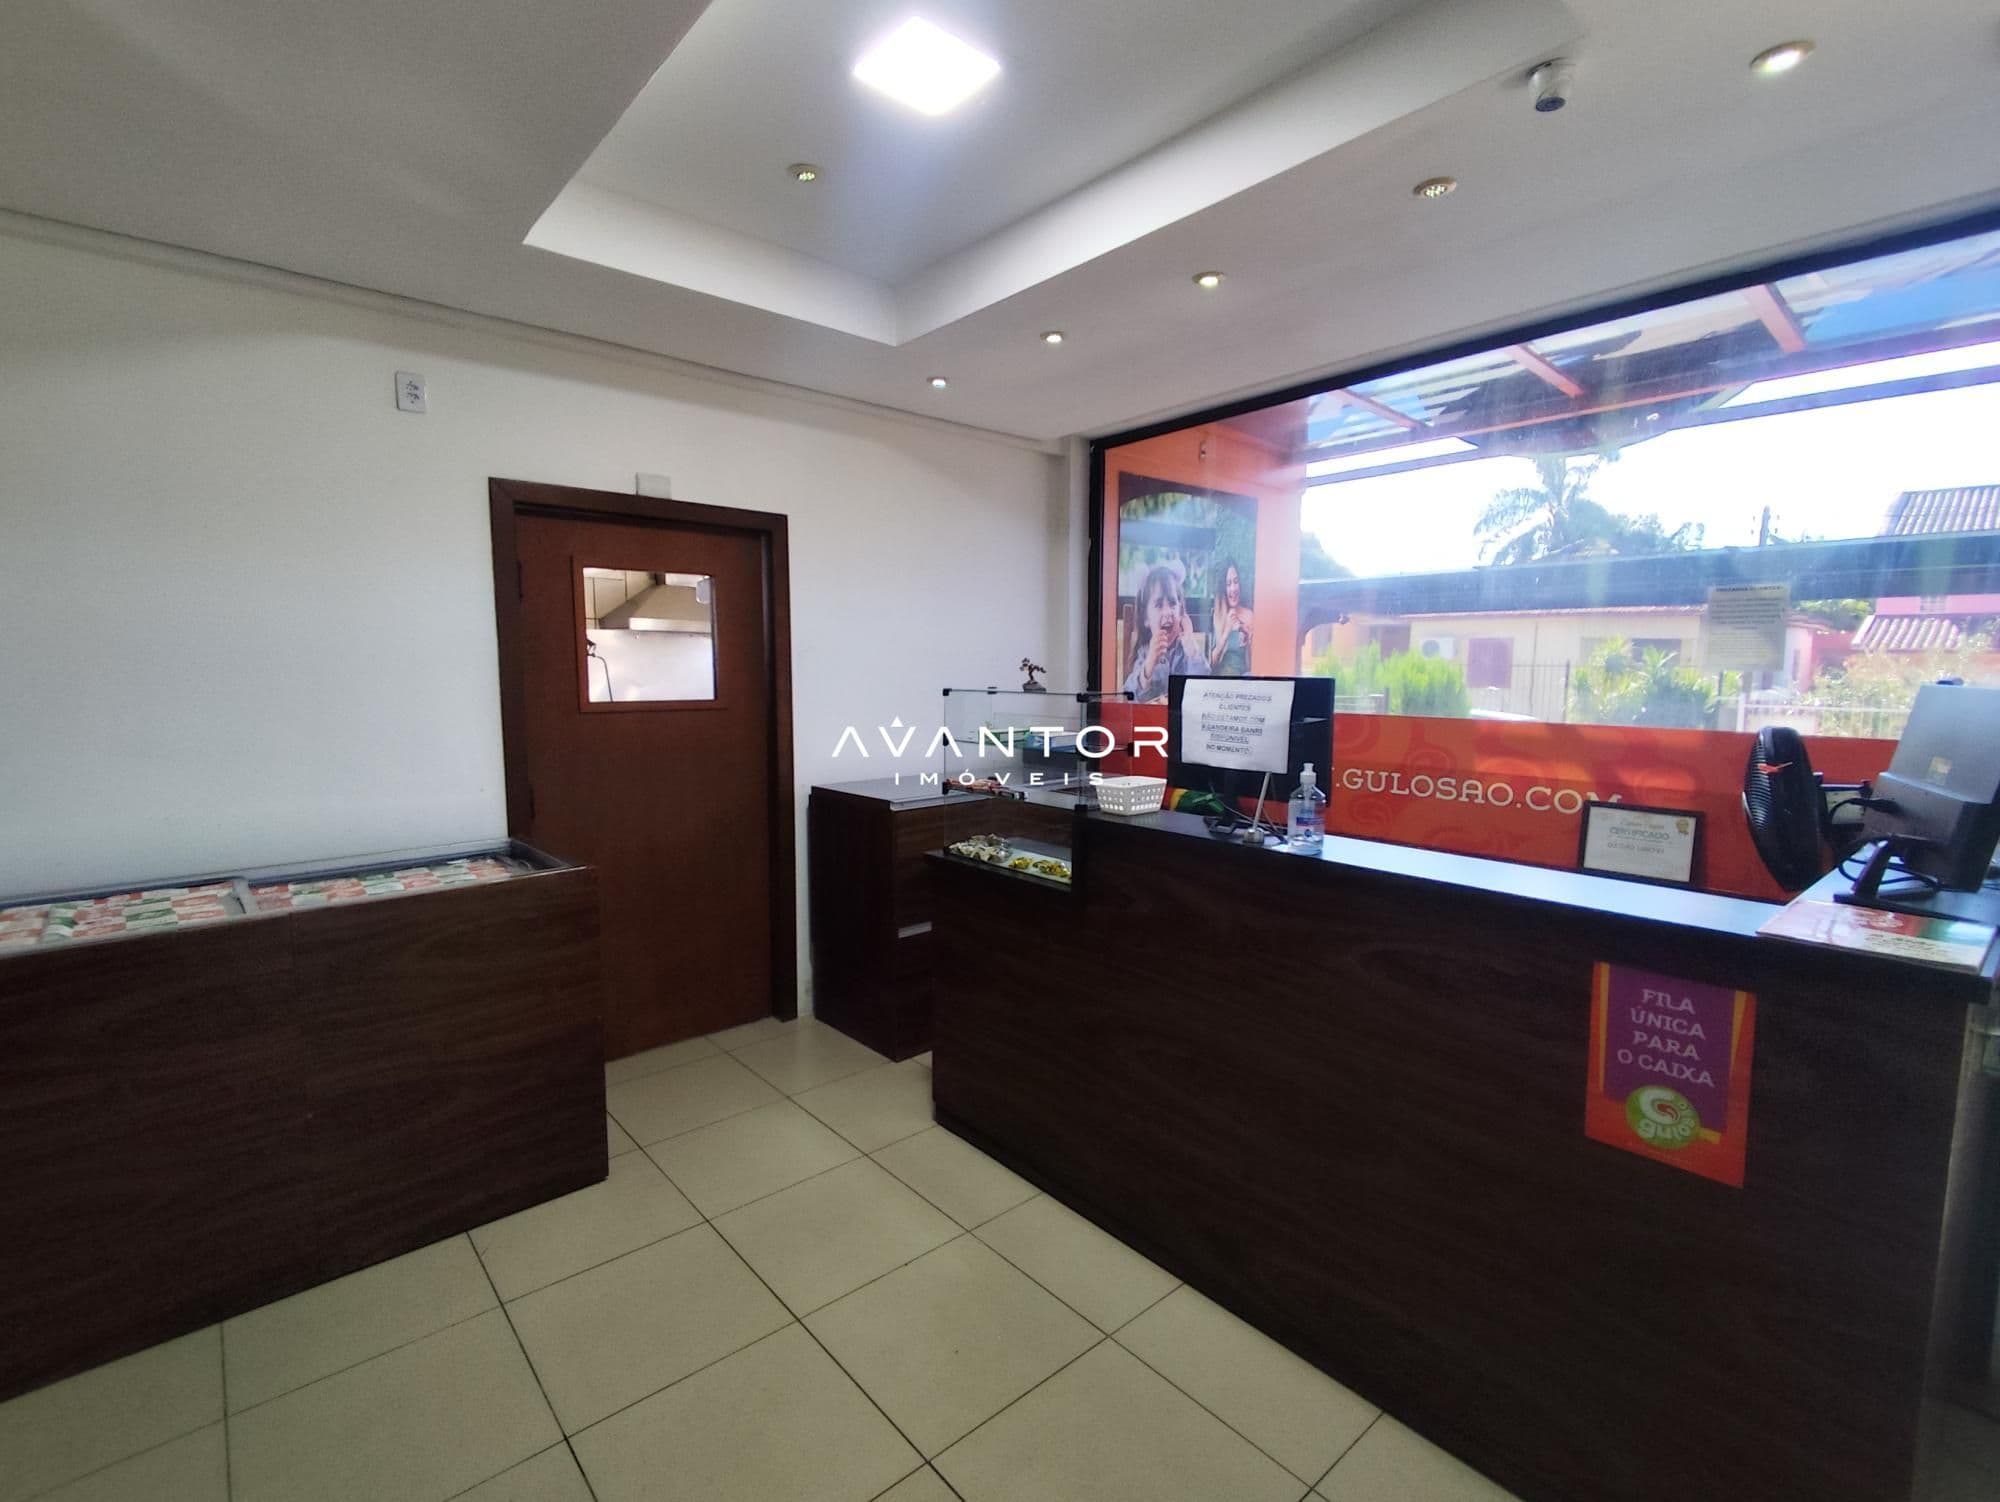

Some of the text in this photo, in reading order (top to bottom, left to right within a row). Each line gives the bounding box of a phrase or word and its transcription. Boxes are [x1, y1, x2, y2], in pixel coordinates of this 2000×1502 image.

[1642, 988, 1696, 1015] FILA
[1630, 1005, 1706, 1040] ÚNICA
[1633, 1030, 1699, 1061] PARA
[1617, 1048, 1715, 1088] O CAIXA
